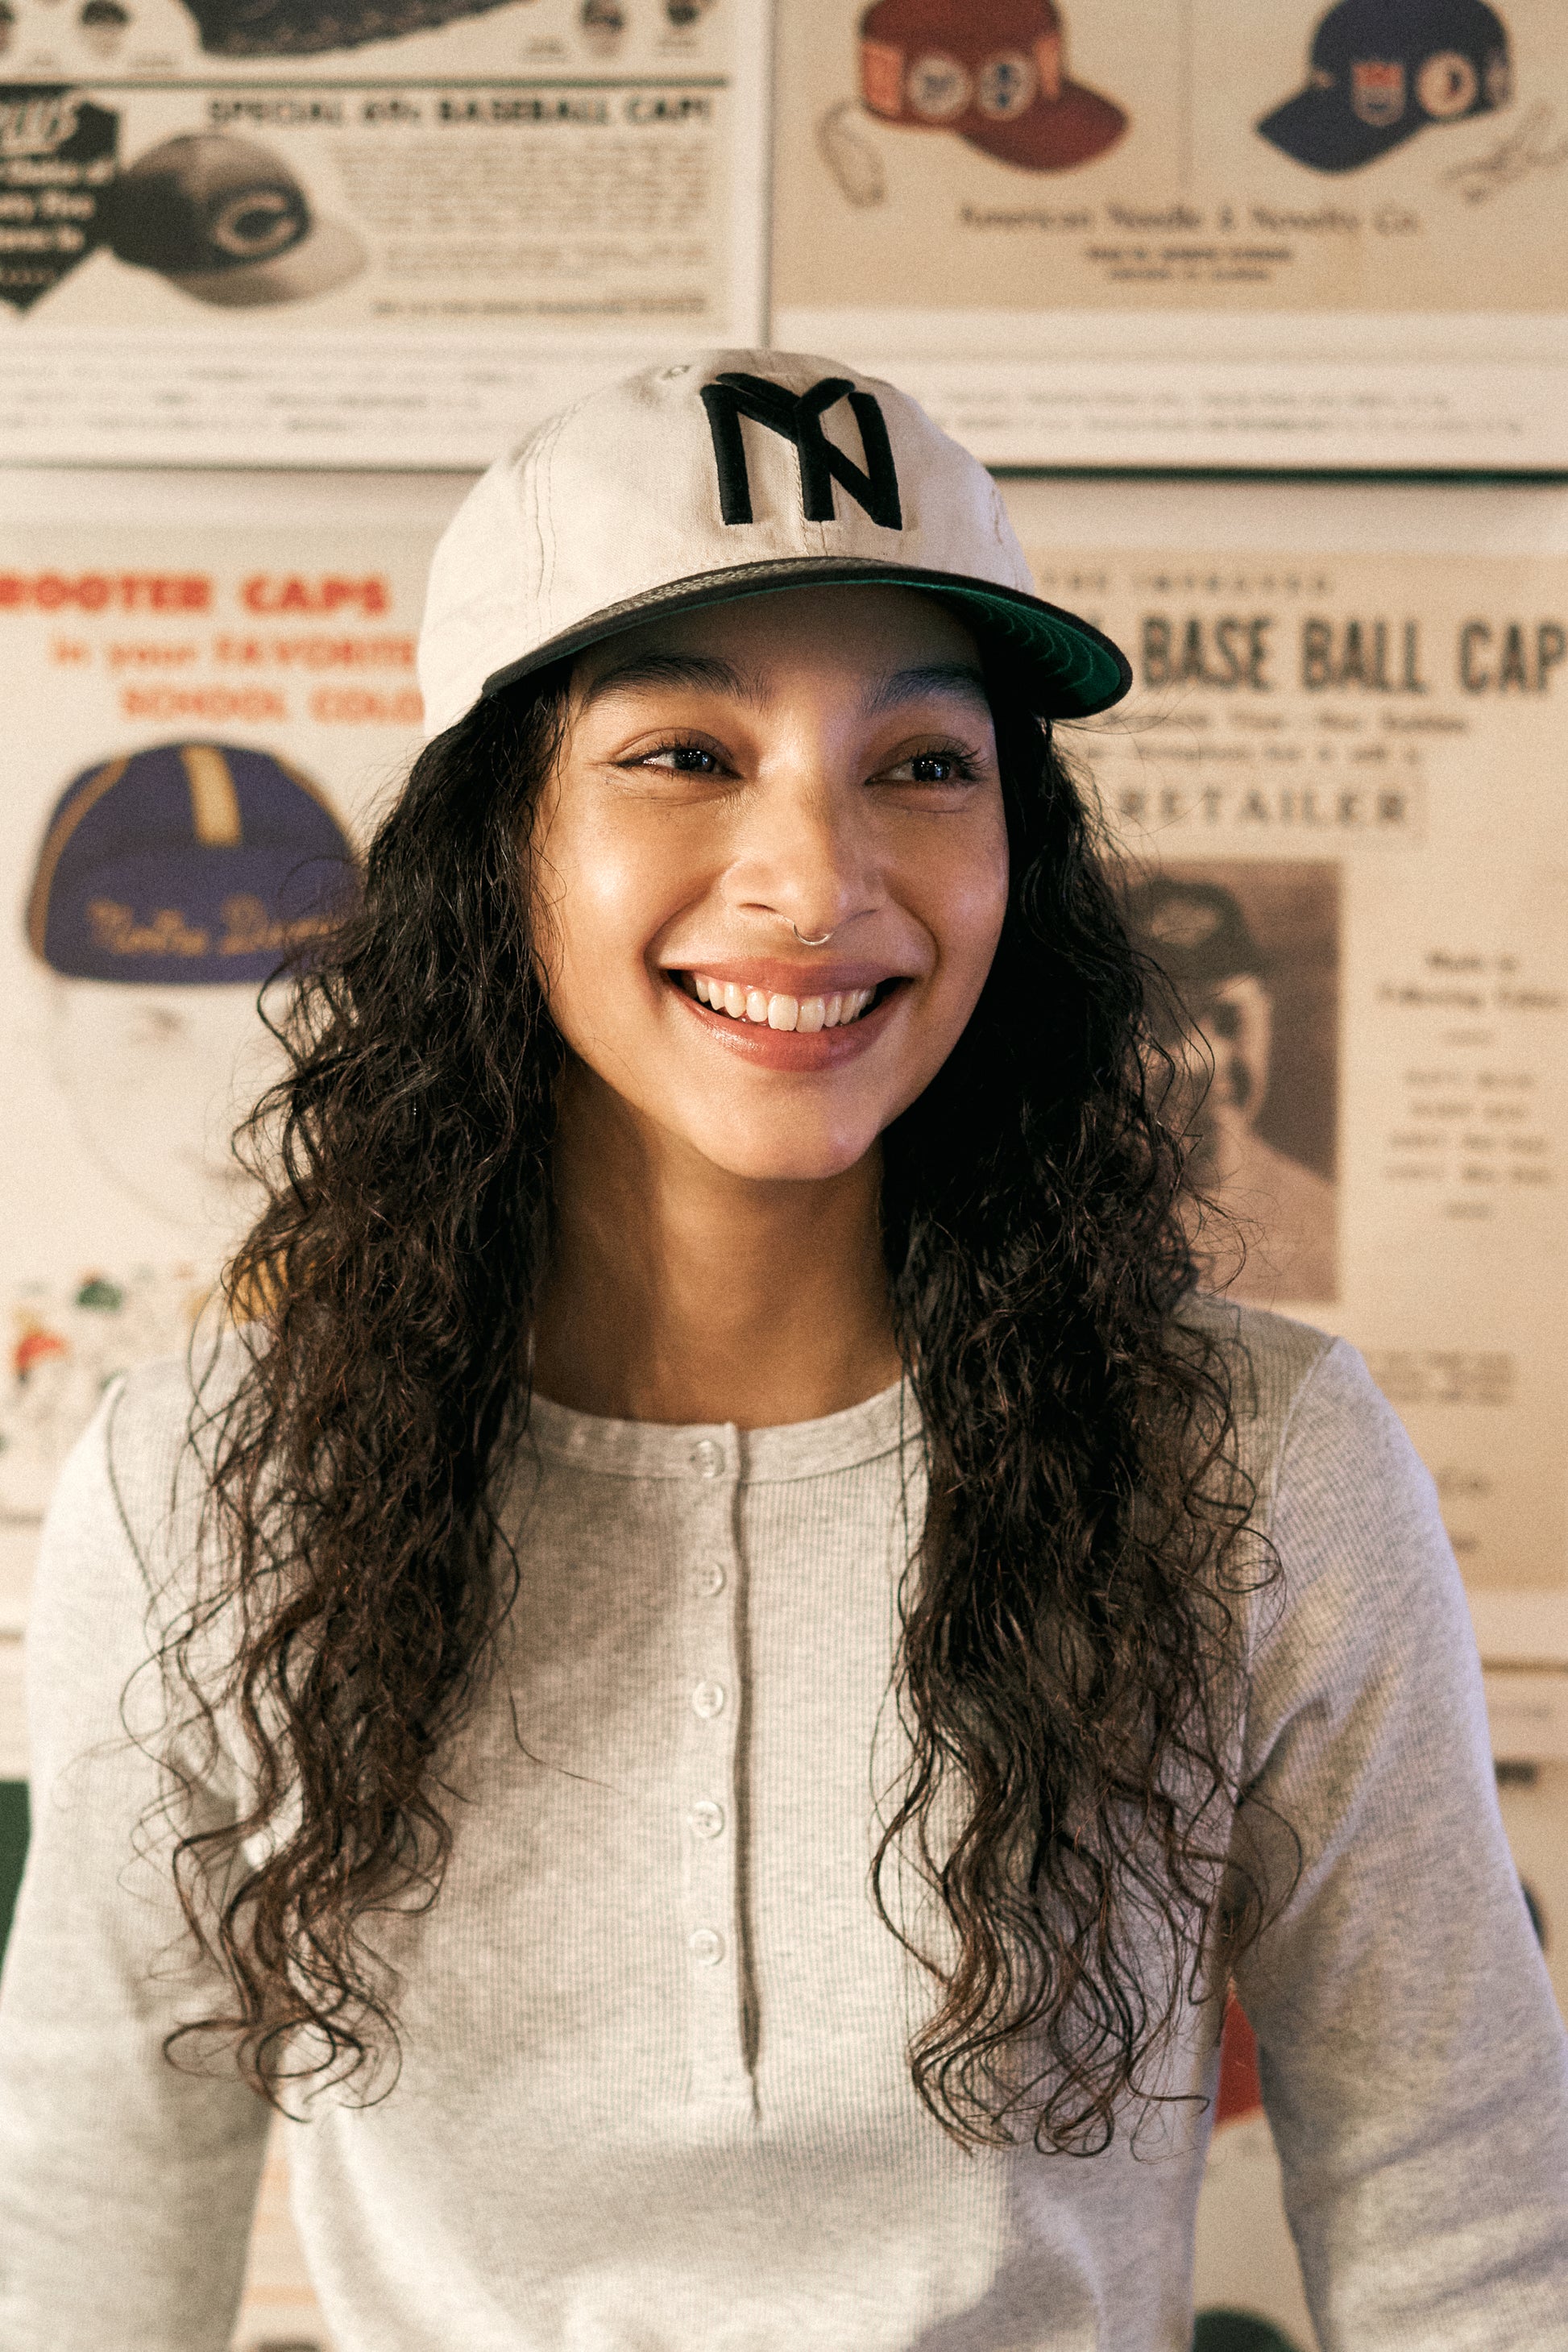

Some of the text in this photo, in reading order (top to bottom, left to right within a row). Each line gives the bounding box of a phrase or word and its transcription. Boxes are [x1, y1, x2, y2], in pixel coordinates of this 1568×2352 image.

[205, 96, 340, 125] SPECIAL
[436, 97, 612, 125] BASEBALL
[959, 203, 1092, 231] American
[1106, 203, 1202, 231] Needle
[0, 573, 391, 617] ROOTER CAPS
[1143, 615, 1568, 695] BASE BALL CAP
[121, 684, 288, 721] SCHOOL
[1119, 788, 1406, 828] RETAILER
